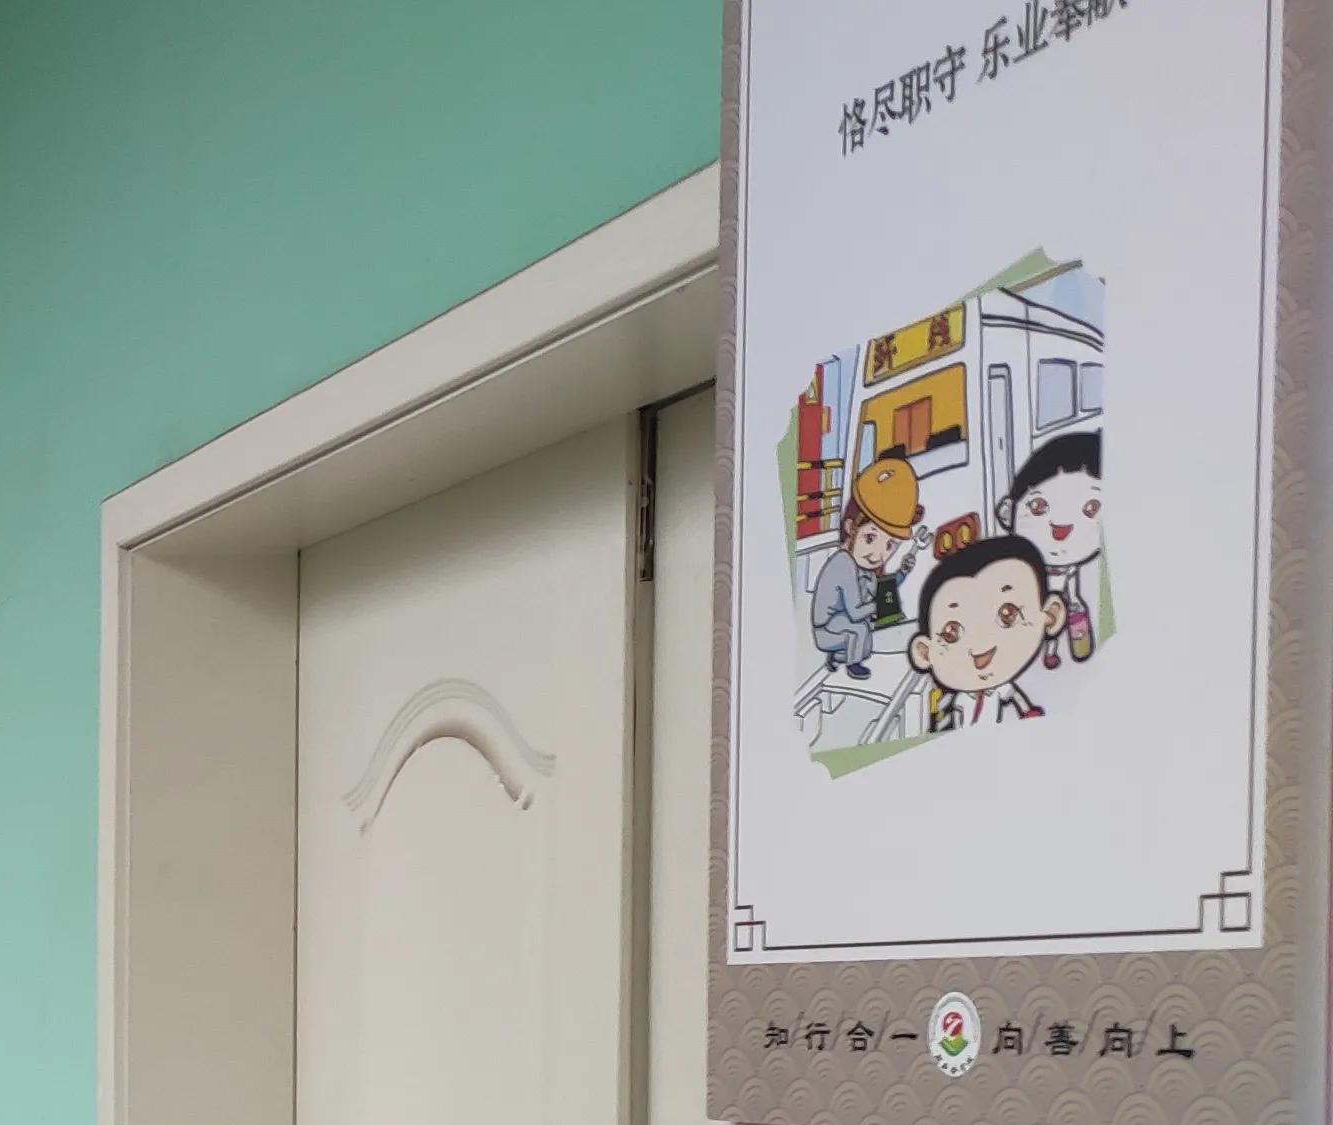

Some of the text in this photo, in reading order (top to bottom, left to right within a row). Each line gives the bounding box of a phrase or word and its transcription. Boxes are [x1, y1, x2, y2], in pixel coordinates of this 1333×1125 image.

[838, 45, 966, 156] 恪尽职守
[764, 1020, 1195, 1059] 知行合一 向善向上
